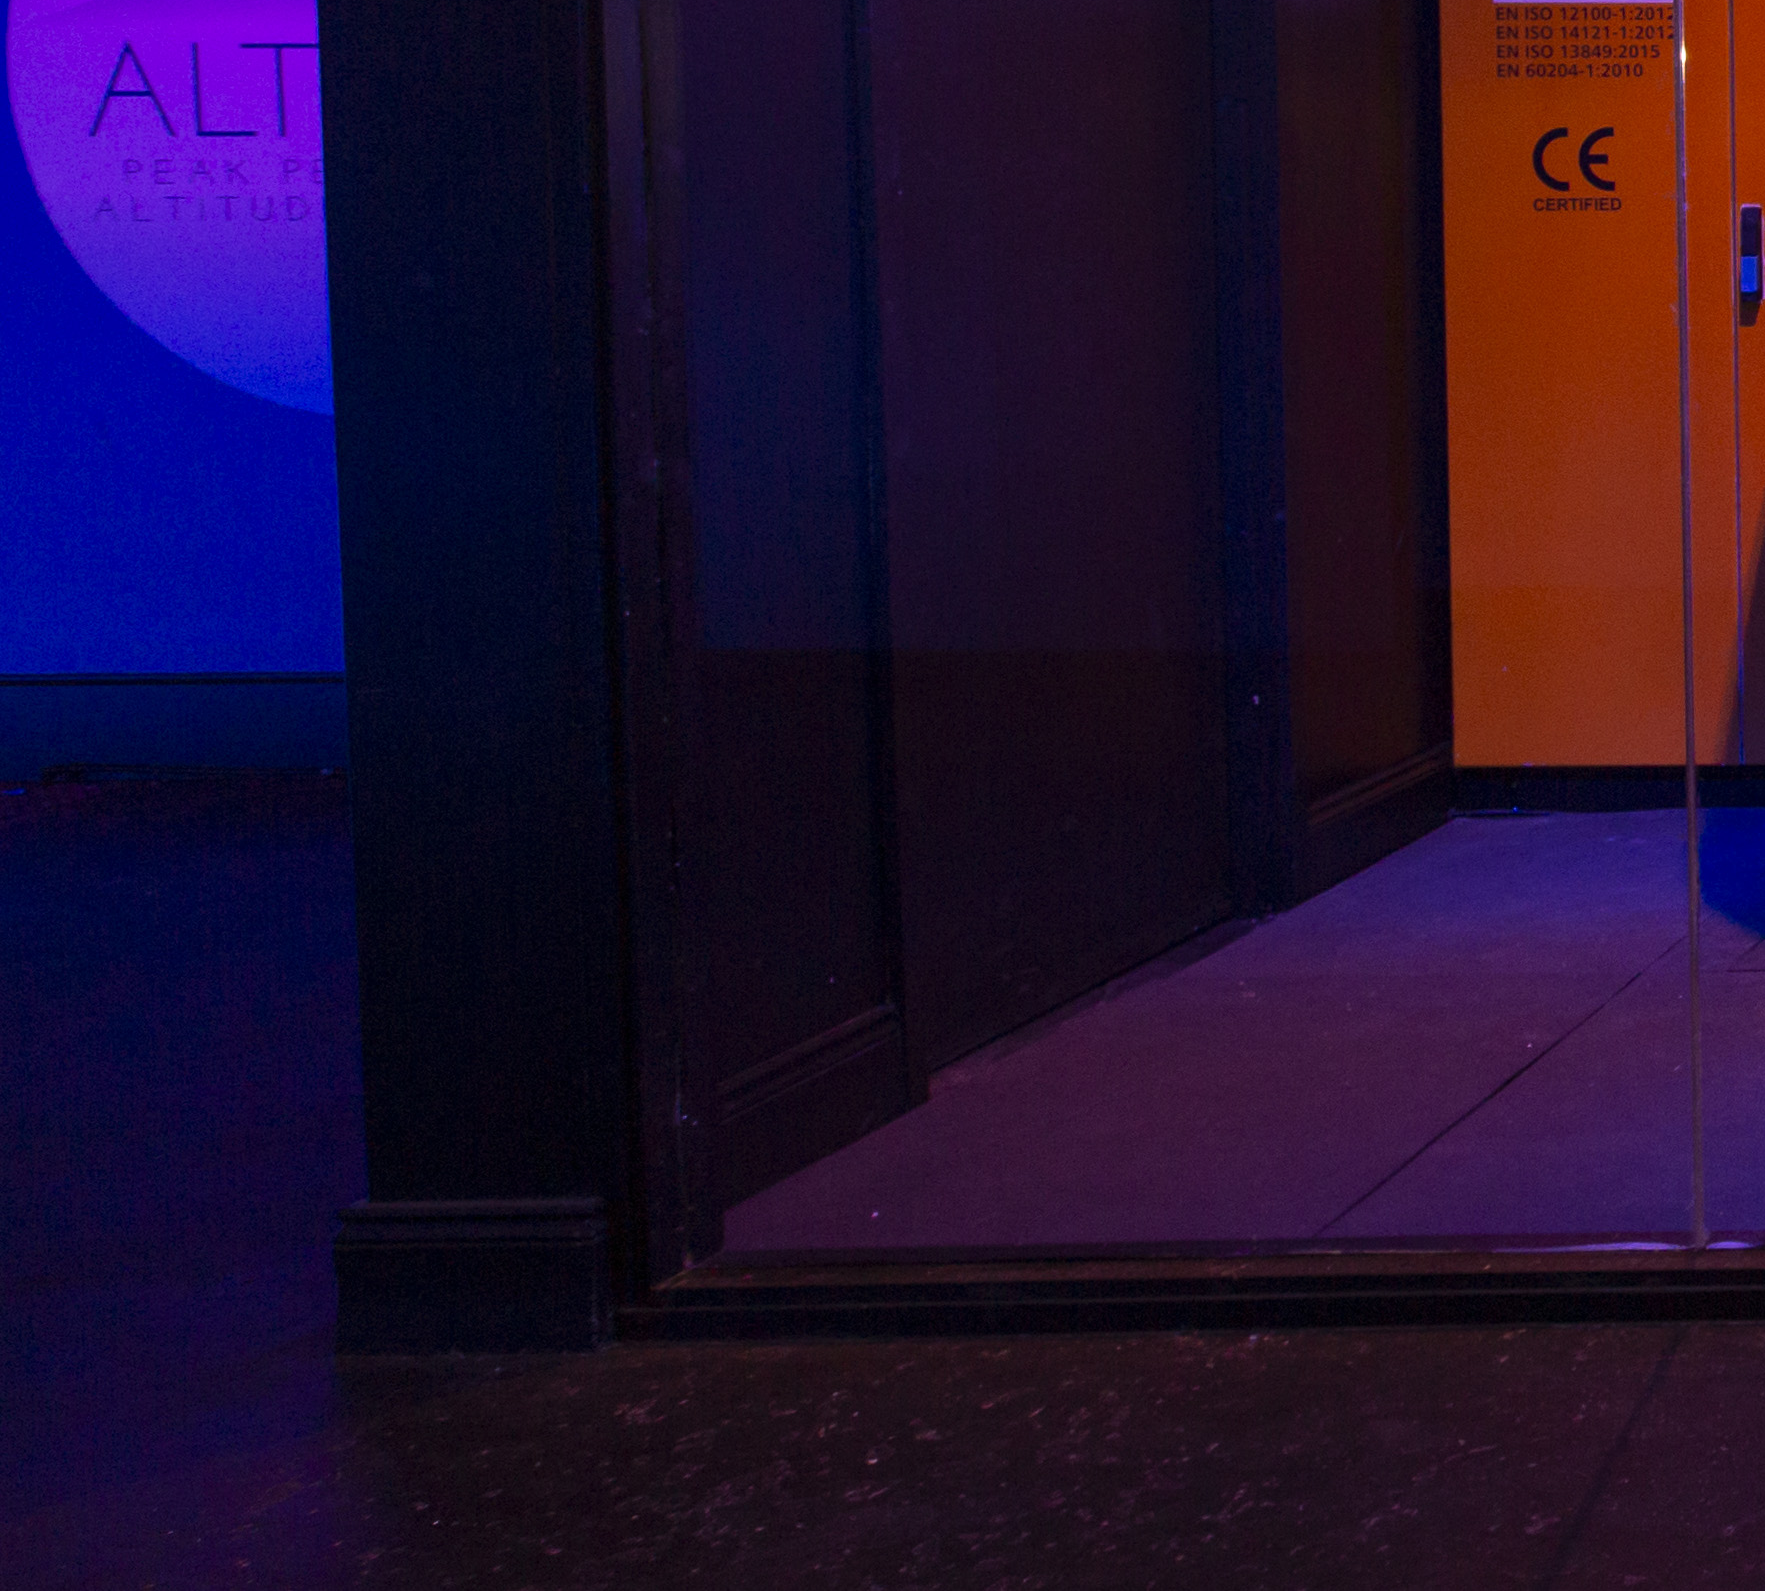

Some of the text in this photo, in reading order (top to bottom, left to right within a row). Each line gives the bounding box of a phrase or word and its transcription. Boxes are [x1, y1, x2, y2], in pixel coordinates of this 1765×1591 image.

[1496, 7, 1674, 21] EN ISO 12100-1:2012
[1496, 26, 1675, 40] EN ISO 14121-1:2012
[1496, 45, 1660, 59] EN ISO 13849:2015
[1497, 64, 1643, 78] EN 60204-1:2010
[123, 159, 249, 185] PEAK
[1533, 198, 1622, 212] CERTIFIED
